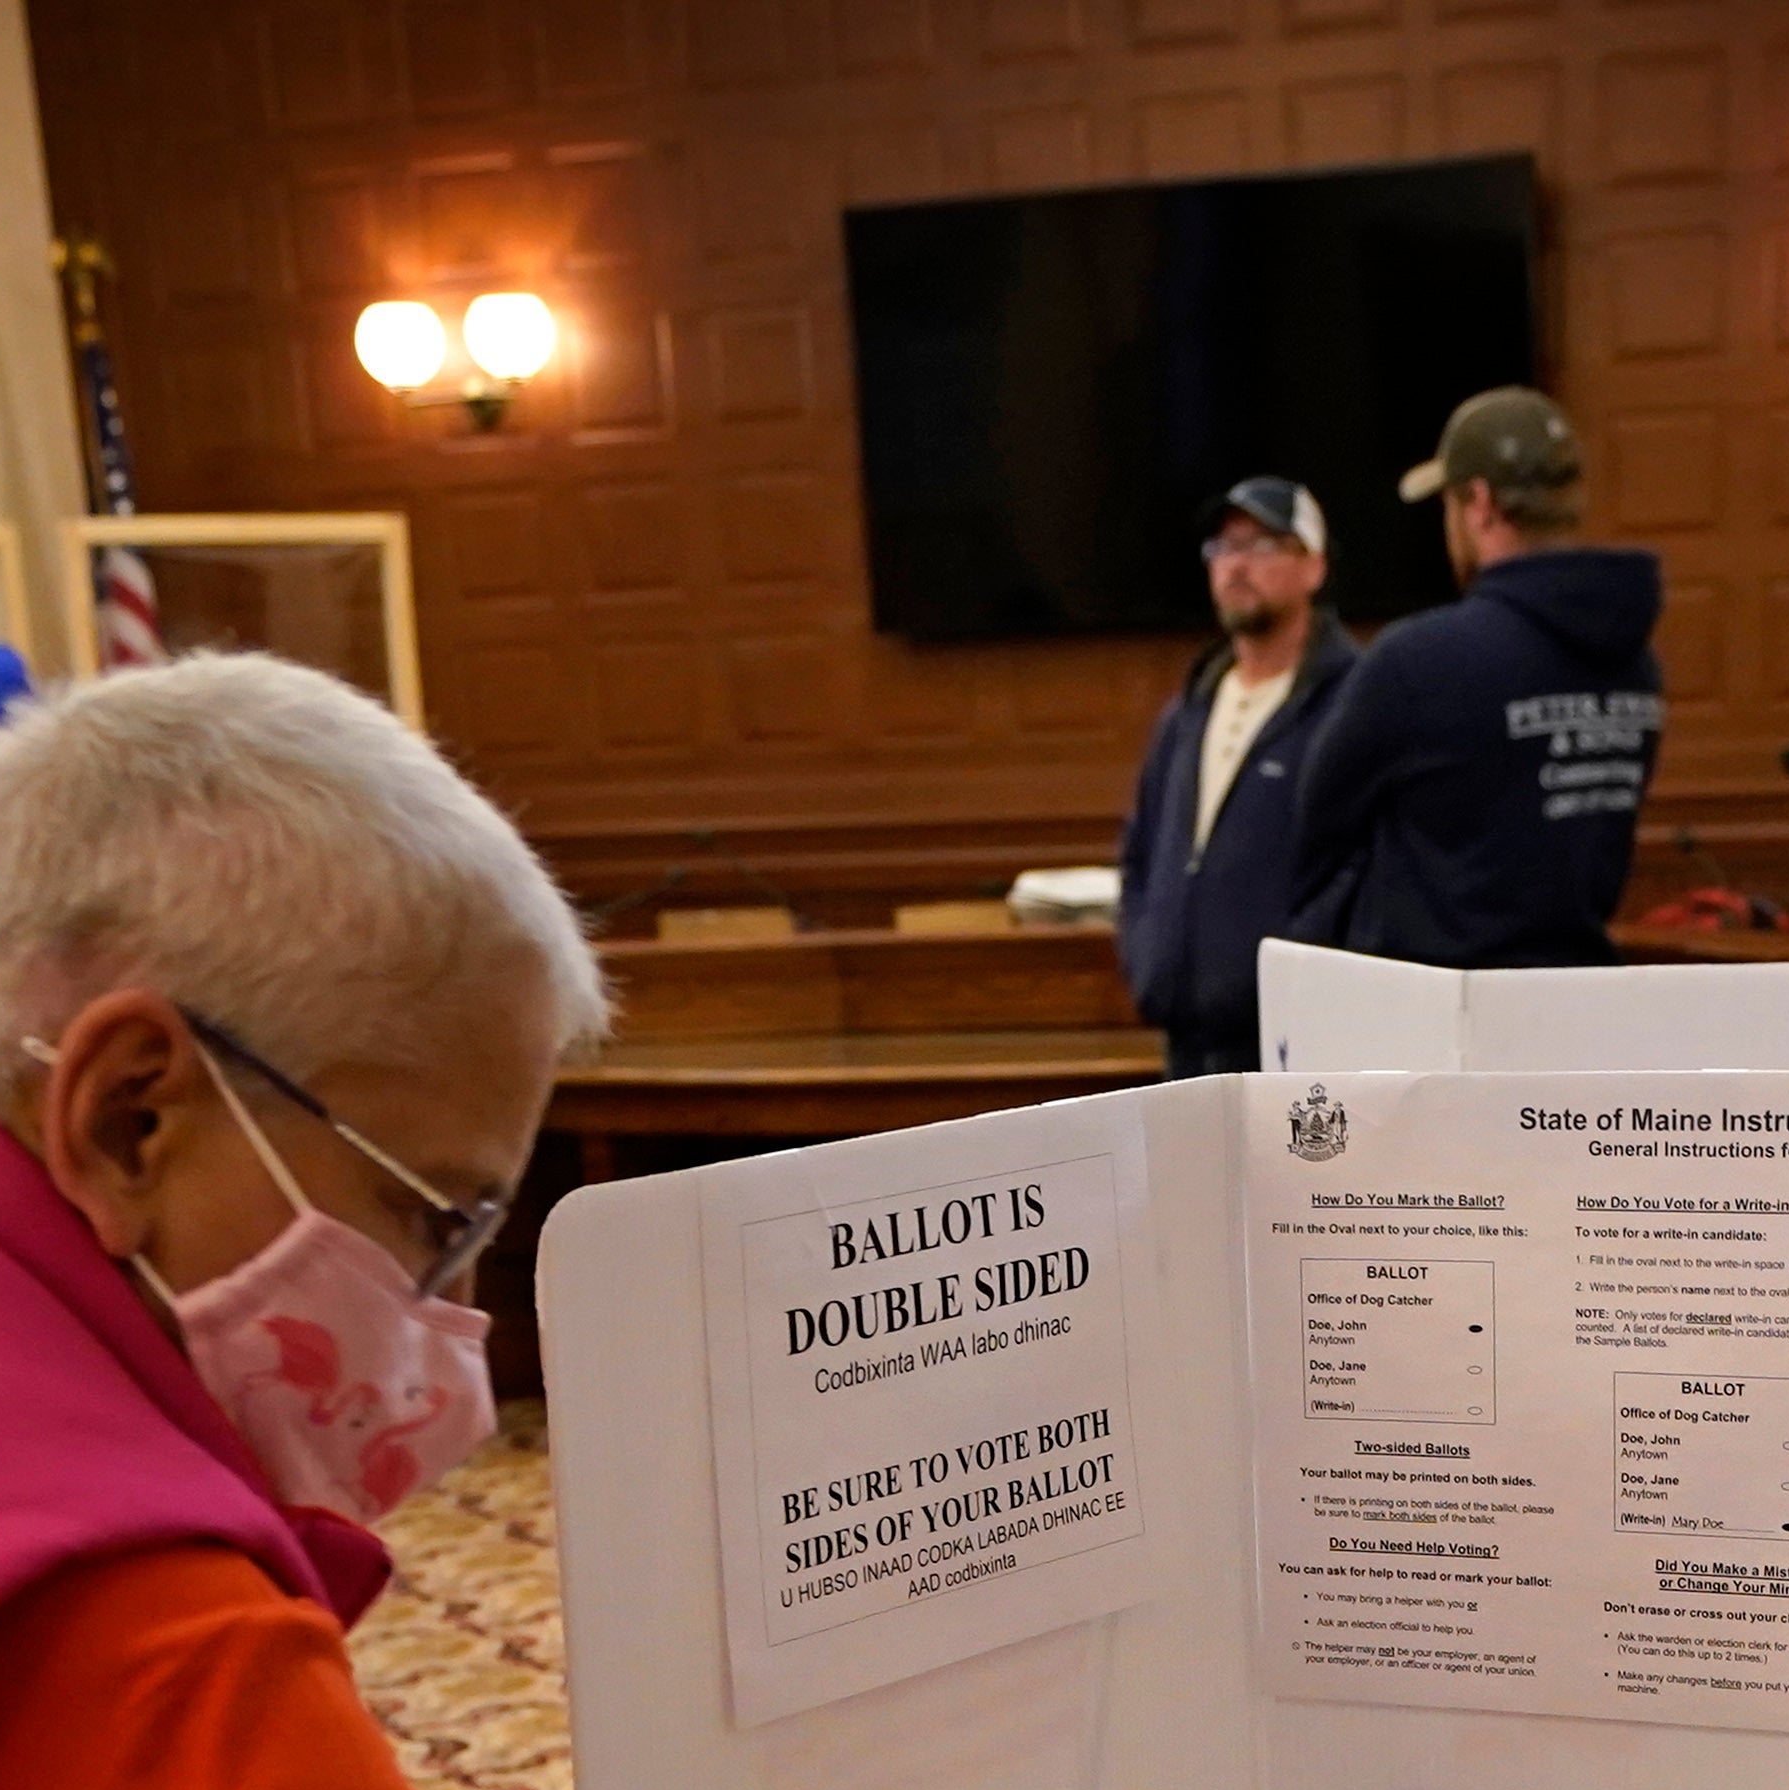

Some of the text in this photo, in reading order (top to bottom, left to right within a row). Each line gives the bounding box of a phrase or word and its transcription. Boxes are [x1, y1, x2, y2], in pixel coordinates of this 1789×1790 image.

[1519, 1107, 1586, 1130] State
[1596, 1107, 1623, 1130] of
[1632, 1108, 1711, 1131] Maine
[1588, 1140, 1657, 1156] General
[1664, 1141, 1774, 1158] Instructions
[1311, 1193, 1504, 1208] How Do You Mark the Ballot?
[1577, 1195, 1606, 1209] How
[1610, 1195, 1629, 1210] Do
[1633, 1196, 1659, 1210] You
[1664, 1197, 1694, 1210] Vote
[1698, 1197, 1718, 1209] for
[1722, 1200, 1730, 1211] a
[1734, 1198, 1789, 1211] Write-in
[830, 1184, 1044, 1269] BALLOT IS
[1366, 1265, 1428, 1279] BALLOT
[785, 1247, 1088, 1355] DOUBLE SIDED
[1307, 1293, 1432, 1307] Office of Dog Catcher
[1308, 1319, 1366, 1331] Doe, John
[814, 1315, 1071, 1393] Codbixinta WAA labo dhinac
[1354, 1440, 1470, 1456] Two-sided Ballots
[781, 1408, 1110, 1524] BE SURE TO VOTE BOTH
[785, 1453, 1113, 1573] SIDES OF YOUR BALLOT
[780, 1490, 1125, 1607] U HUBSO INAAD CODKA LABADA DHINAC EE
[908, 1553, 1016, 1598] AAD codbixinta
